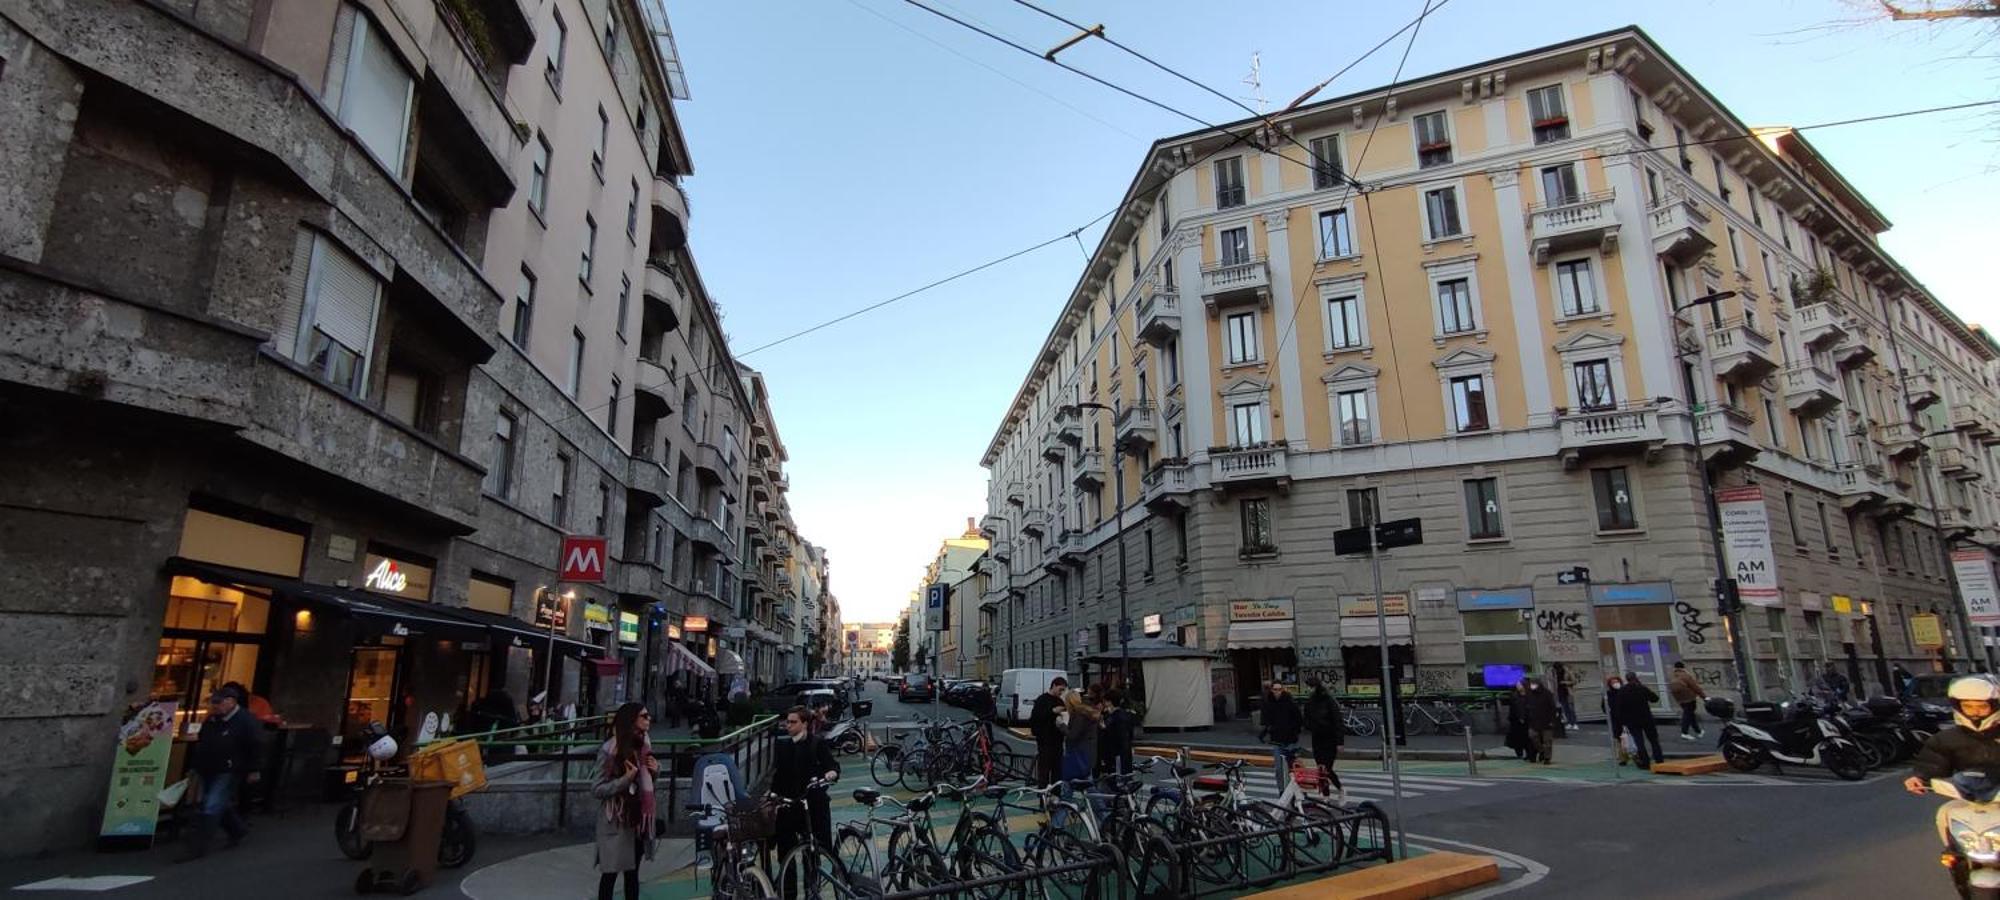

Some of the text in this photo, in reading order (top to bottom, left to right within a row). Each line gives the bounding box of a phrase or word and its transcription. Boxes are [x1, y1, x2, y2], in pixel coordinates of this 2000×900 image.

[564, 546, 601, 573] M
[1737, 560, 1765, 571] AM
[364, 557, 407, 592] Alice
[1737, 573, 1756, 584] MI
[931, 589, 939, 606] P
[1971, 597, 1991, 605] AM
